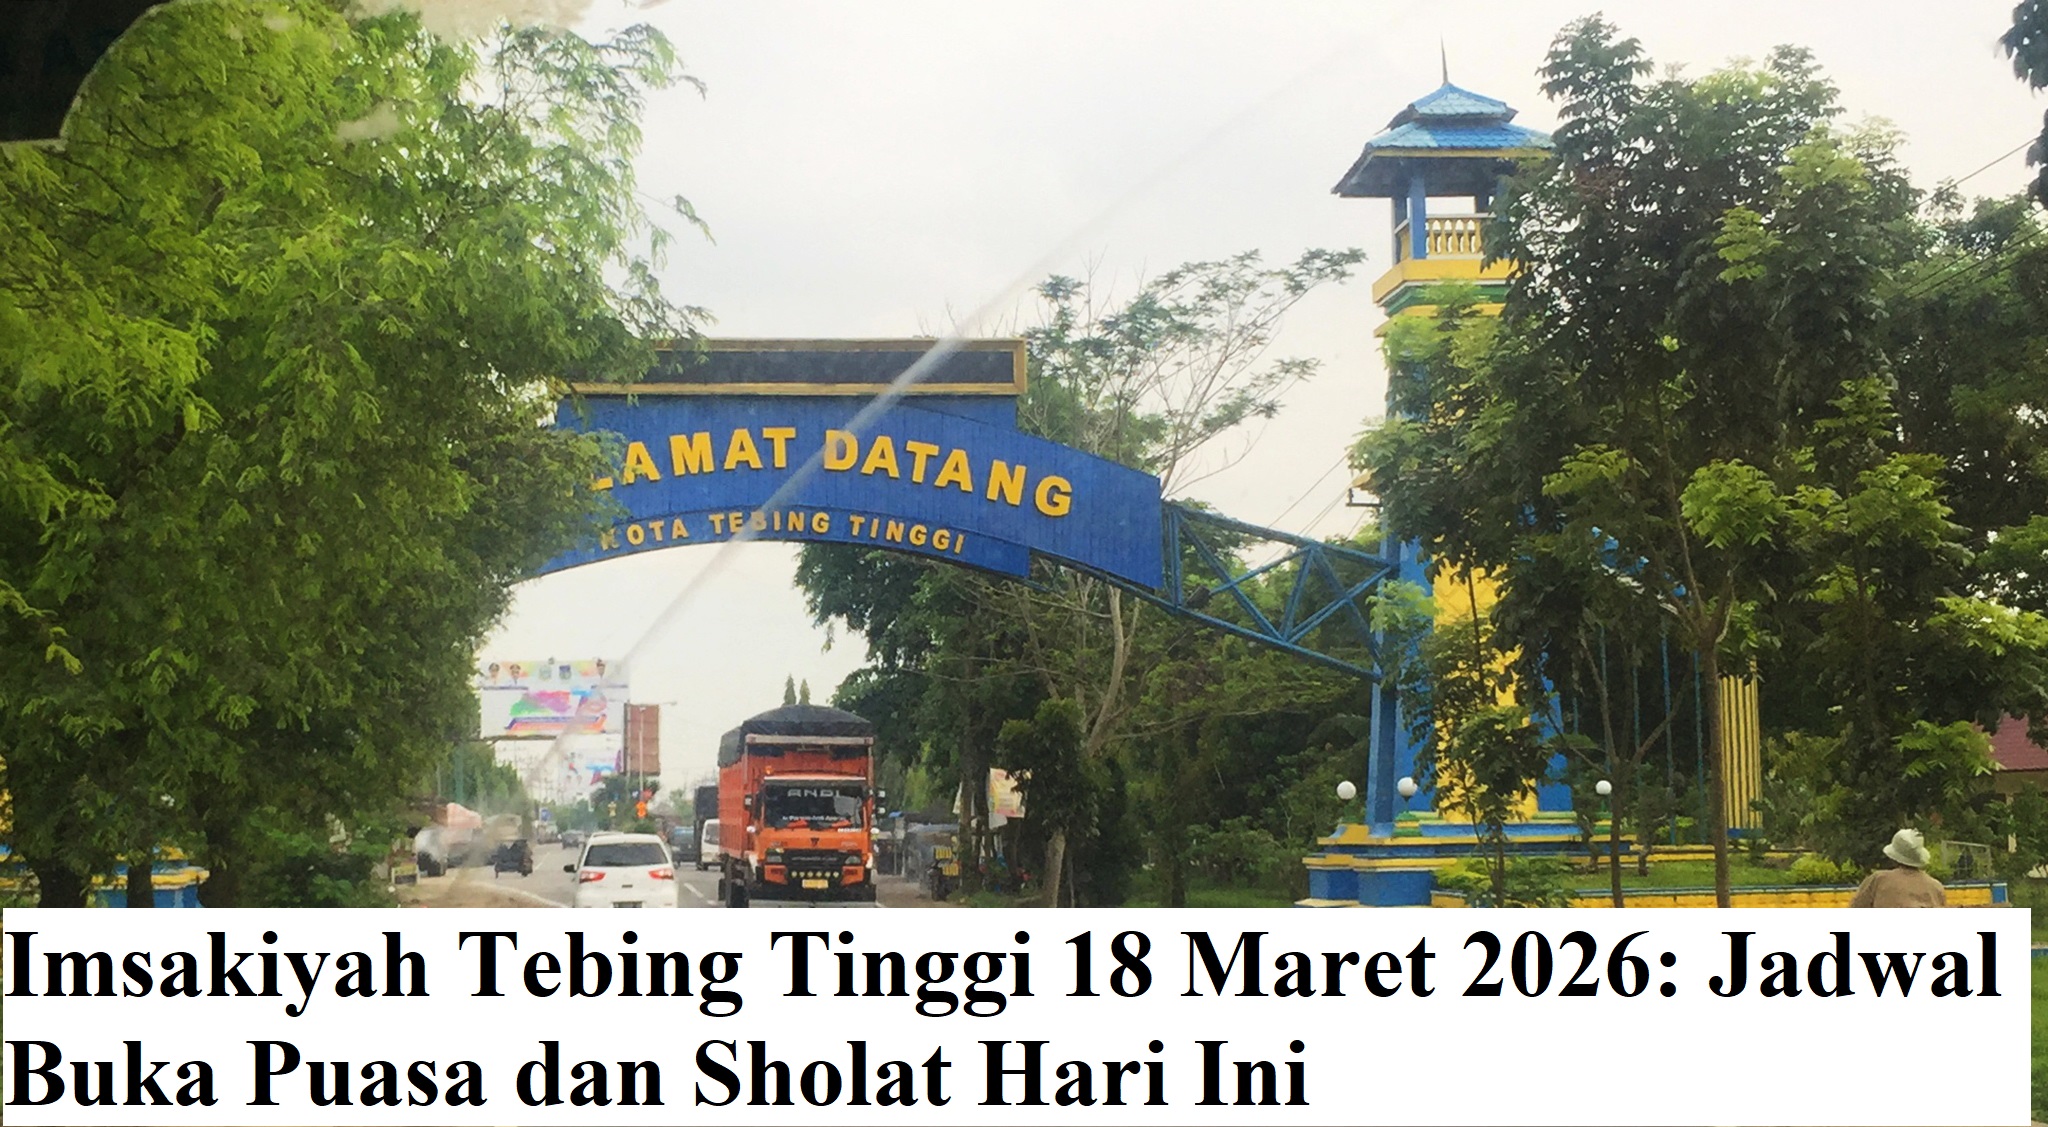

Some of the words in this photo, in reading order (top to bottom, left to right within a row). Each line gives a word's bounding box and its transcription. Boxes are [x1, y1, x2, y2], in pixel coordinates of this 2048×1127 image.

[589, 427, 797, 491] AMAT
[824, 429, 1073, 517] DATANG
[601, 518, 690, 551] KOTA
[708, 510, 830, 535] TEBING
[850, 515, 965, 554] TINGGI
